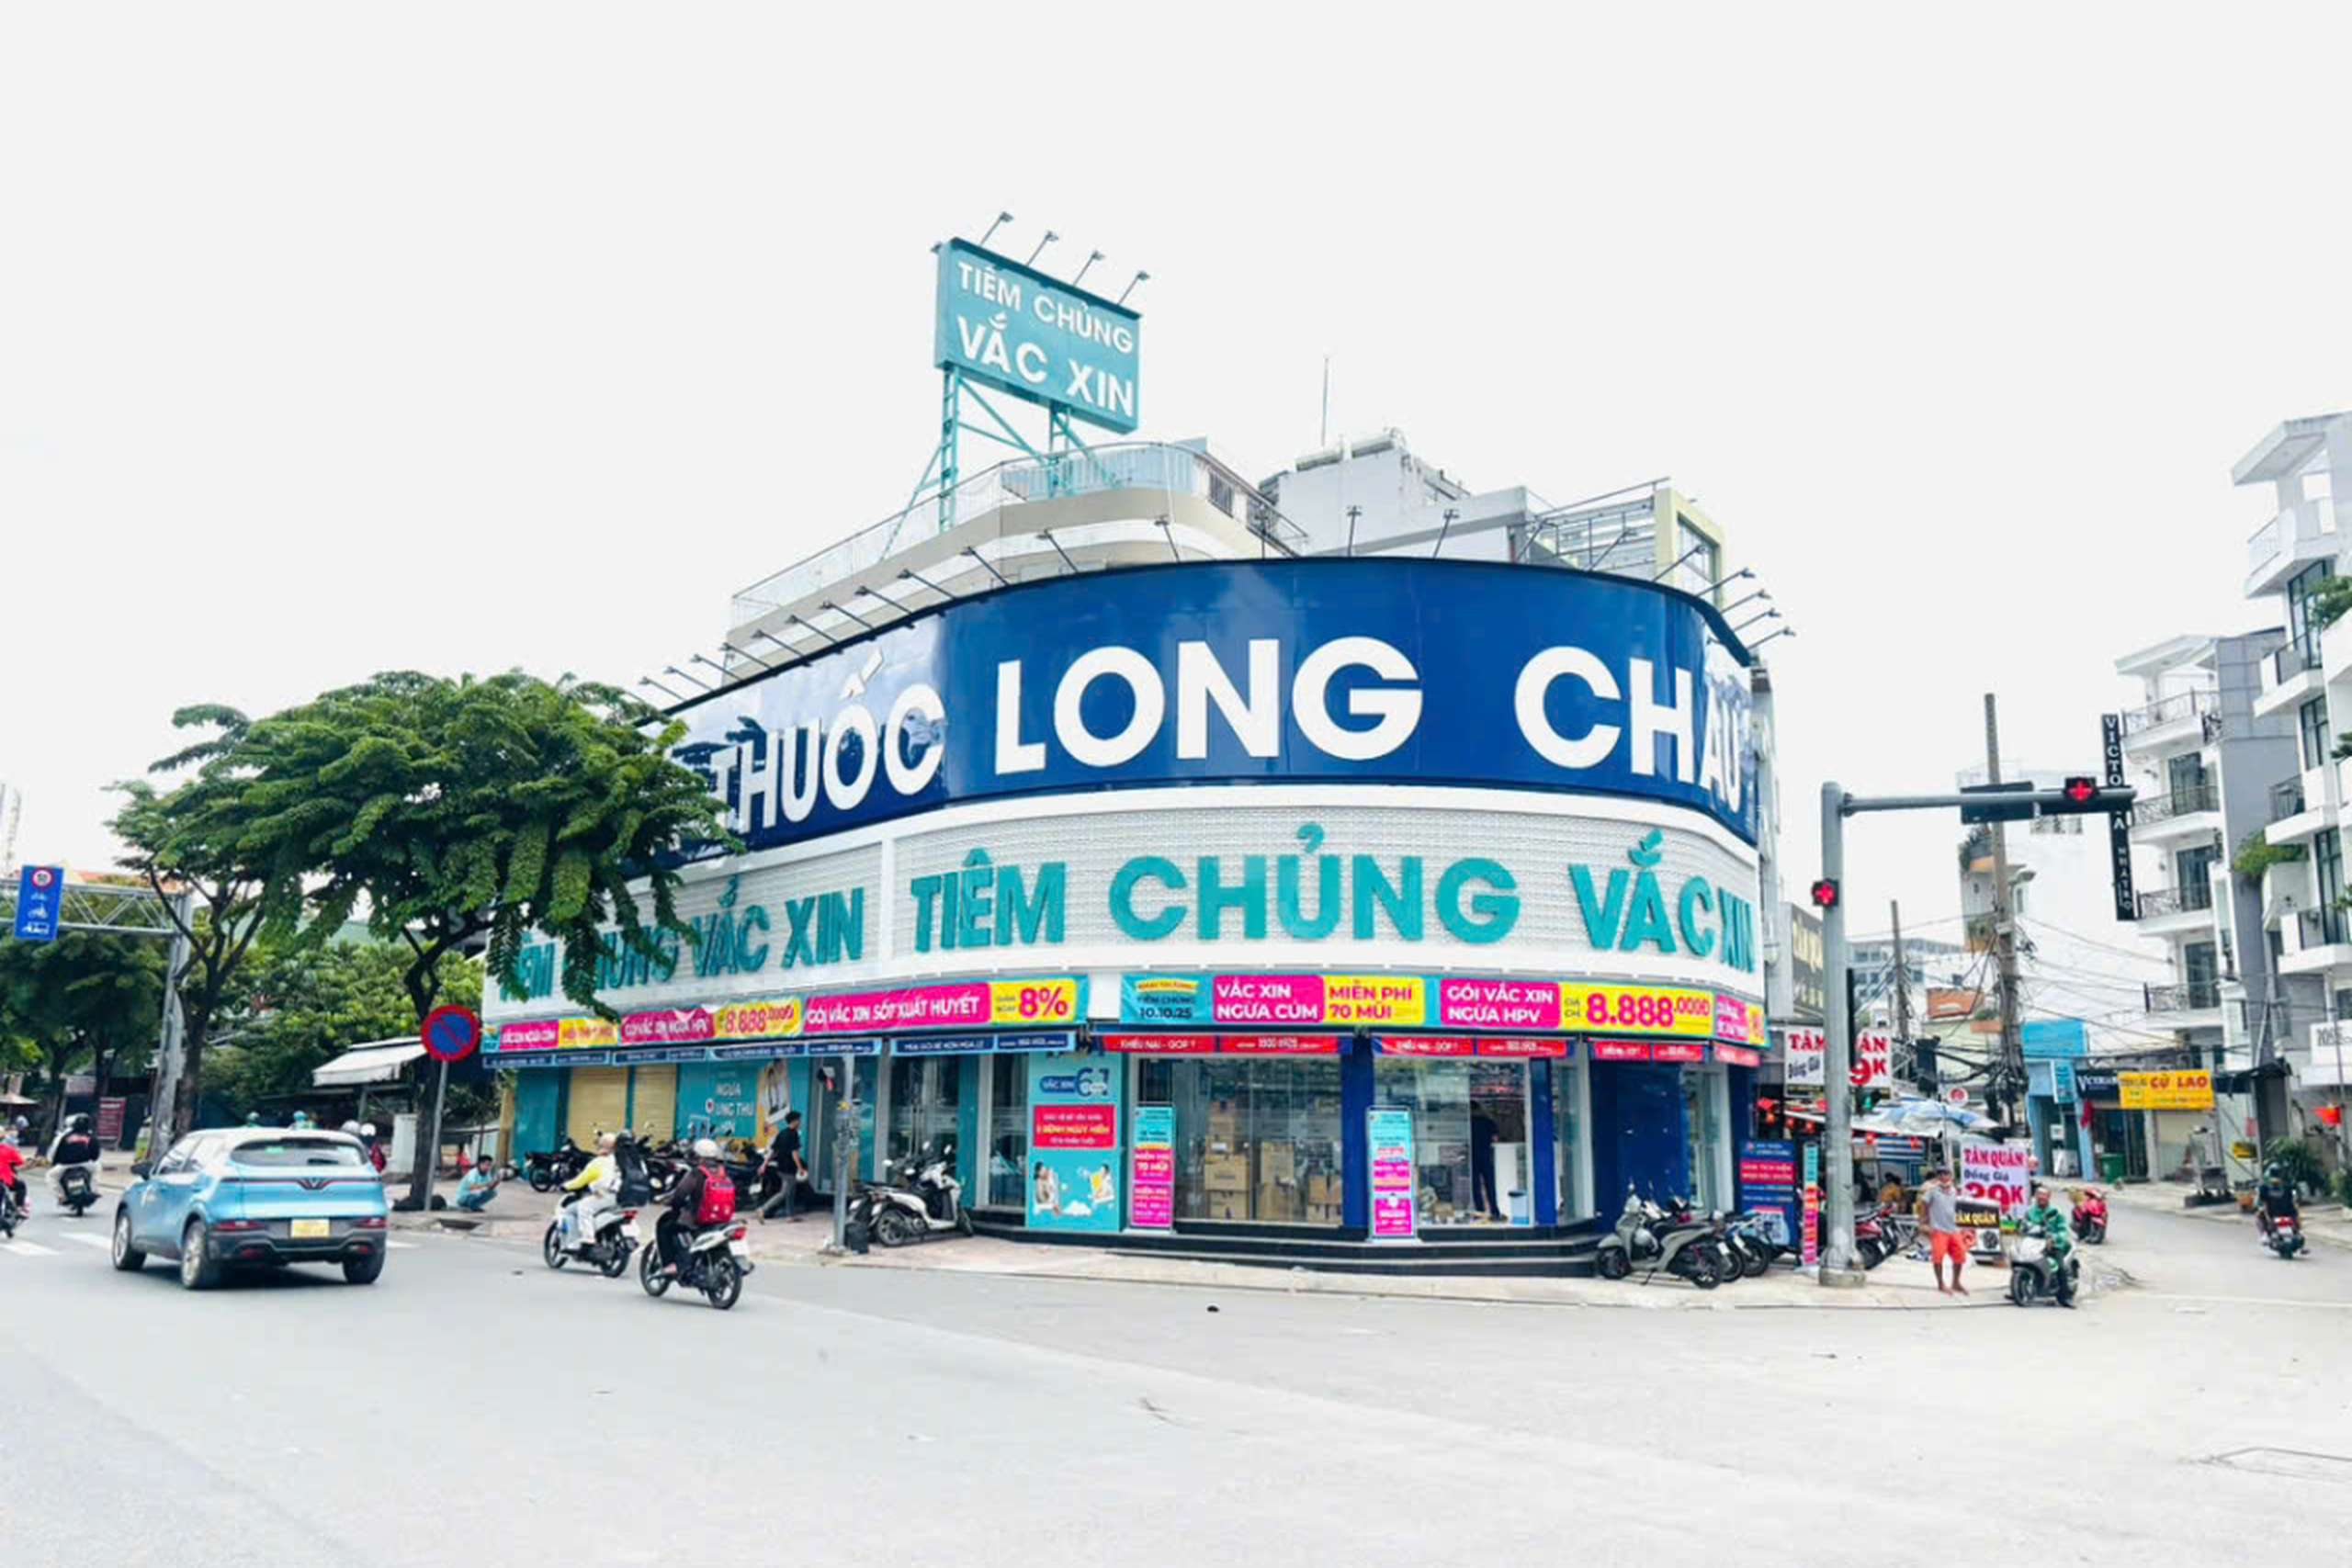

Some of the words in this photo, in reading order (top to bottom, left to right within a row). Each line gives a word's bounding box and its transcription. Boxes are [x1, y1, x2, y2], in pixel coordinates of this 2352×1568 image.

[957, 261, 1022, 312] TIÊM
[1034, 295, 1133, 354] CHỦNG
[957, 311, 1048, 384] VẮC
[1066, 358, 1133, 418] XIN
[710, 647, 947, 834] THUỐC
[996, 637, 1423, 775] LONG
[910, 847, 1068, 953] TIÊM
[1108, 822, 1521, 942] CHỦNG
[1568, 829, 1716, 957] VẮC
[1718, 887, 1756, 974] XIN
[691, 874, 770, 978] VẮC
[781, 887, 865, 969] XIN
[1019, 986, 1068, 1018] 8%
[1217, 981, 1255, 998] VẮC
[1260, 985, 1291, 998] XIN
[1329, 979, 1376, 1000] MIỄN
[1381, 983, 1412, 1000] PHÍ
[1447, 985, 1478, 1001] GÓI
[1483, 983, 1521, 1002] VẮC
[1524, 989, 1554, 1004] XIN
[1329, 1005, 1351, 1020] 70
[1503, 1010, 1541, 1022] HPV
